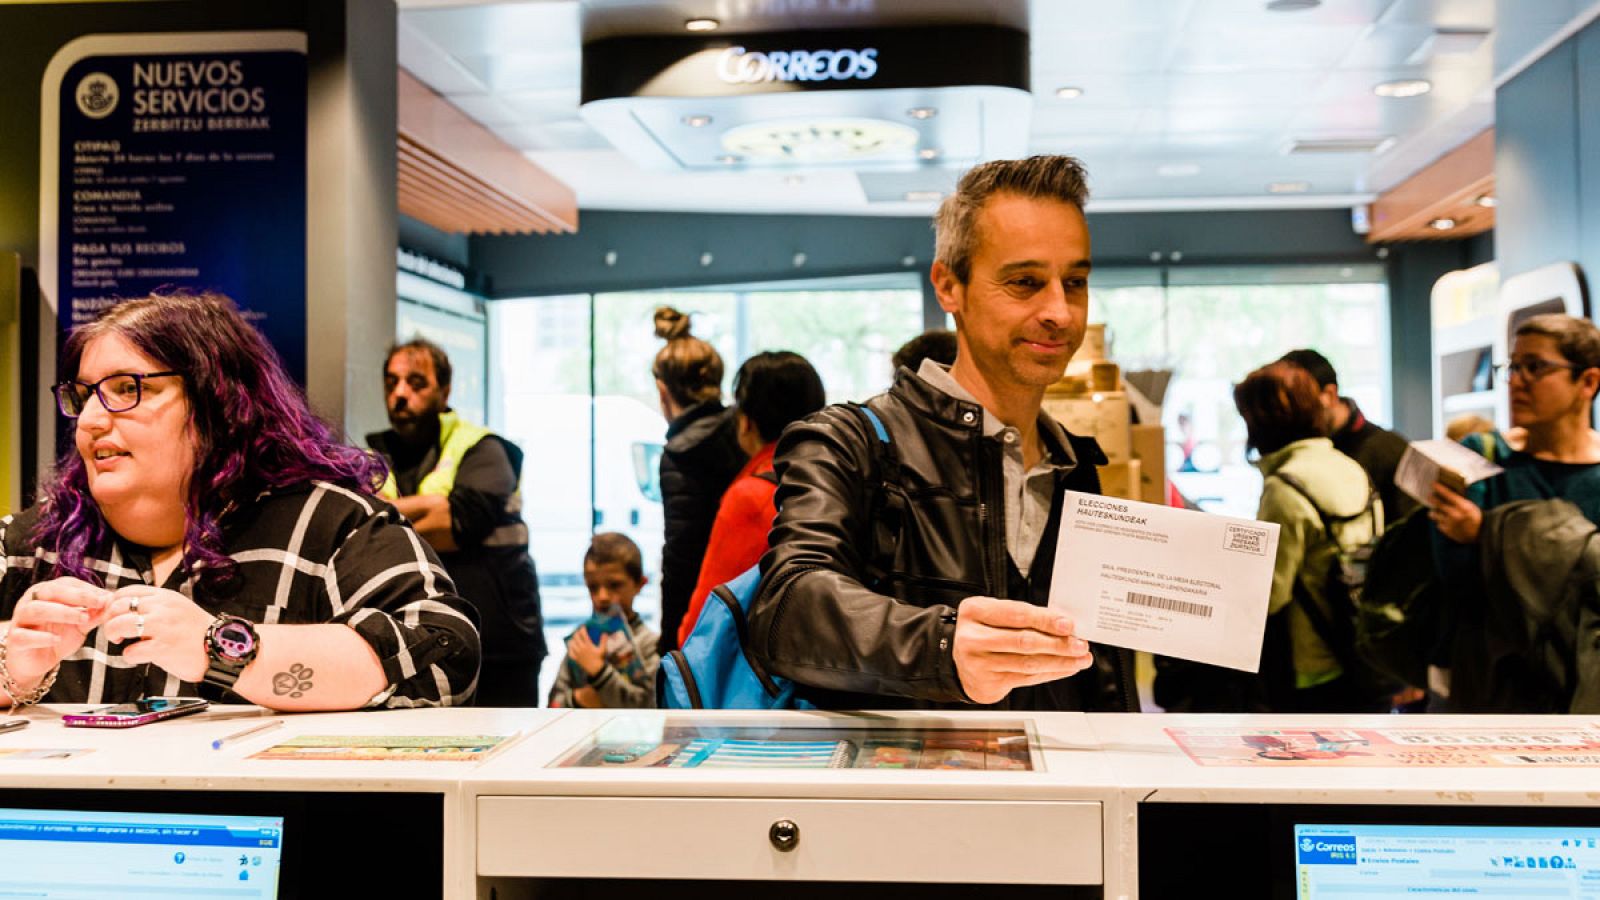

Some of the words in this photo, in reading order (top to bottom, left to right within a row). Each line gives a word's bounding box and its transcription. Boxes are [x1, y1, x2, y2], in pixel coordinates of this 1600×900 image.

[133, 60, 243, 87] NUEVOS
[133, 87, 266, 115] SERVICIOS
[133, 117, 202, 132] ZERBITZU
[207, 116, 270, 131] BERRIAK
[73, 243, 107, 254] PAGA
[110, 243, 132, 254] TUS
[135, 242, 186, 254] RECIBOS
[1078, 498, 1129, 513] ELECCIONES
[1076, 508, 1148, 525] HAUTESKUNDEAK
[1229, 526, 1266, 537] CERTIFICADO
[1316, 842, 1355, 852] Correos
